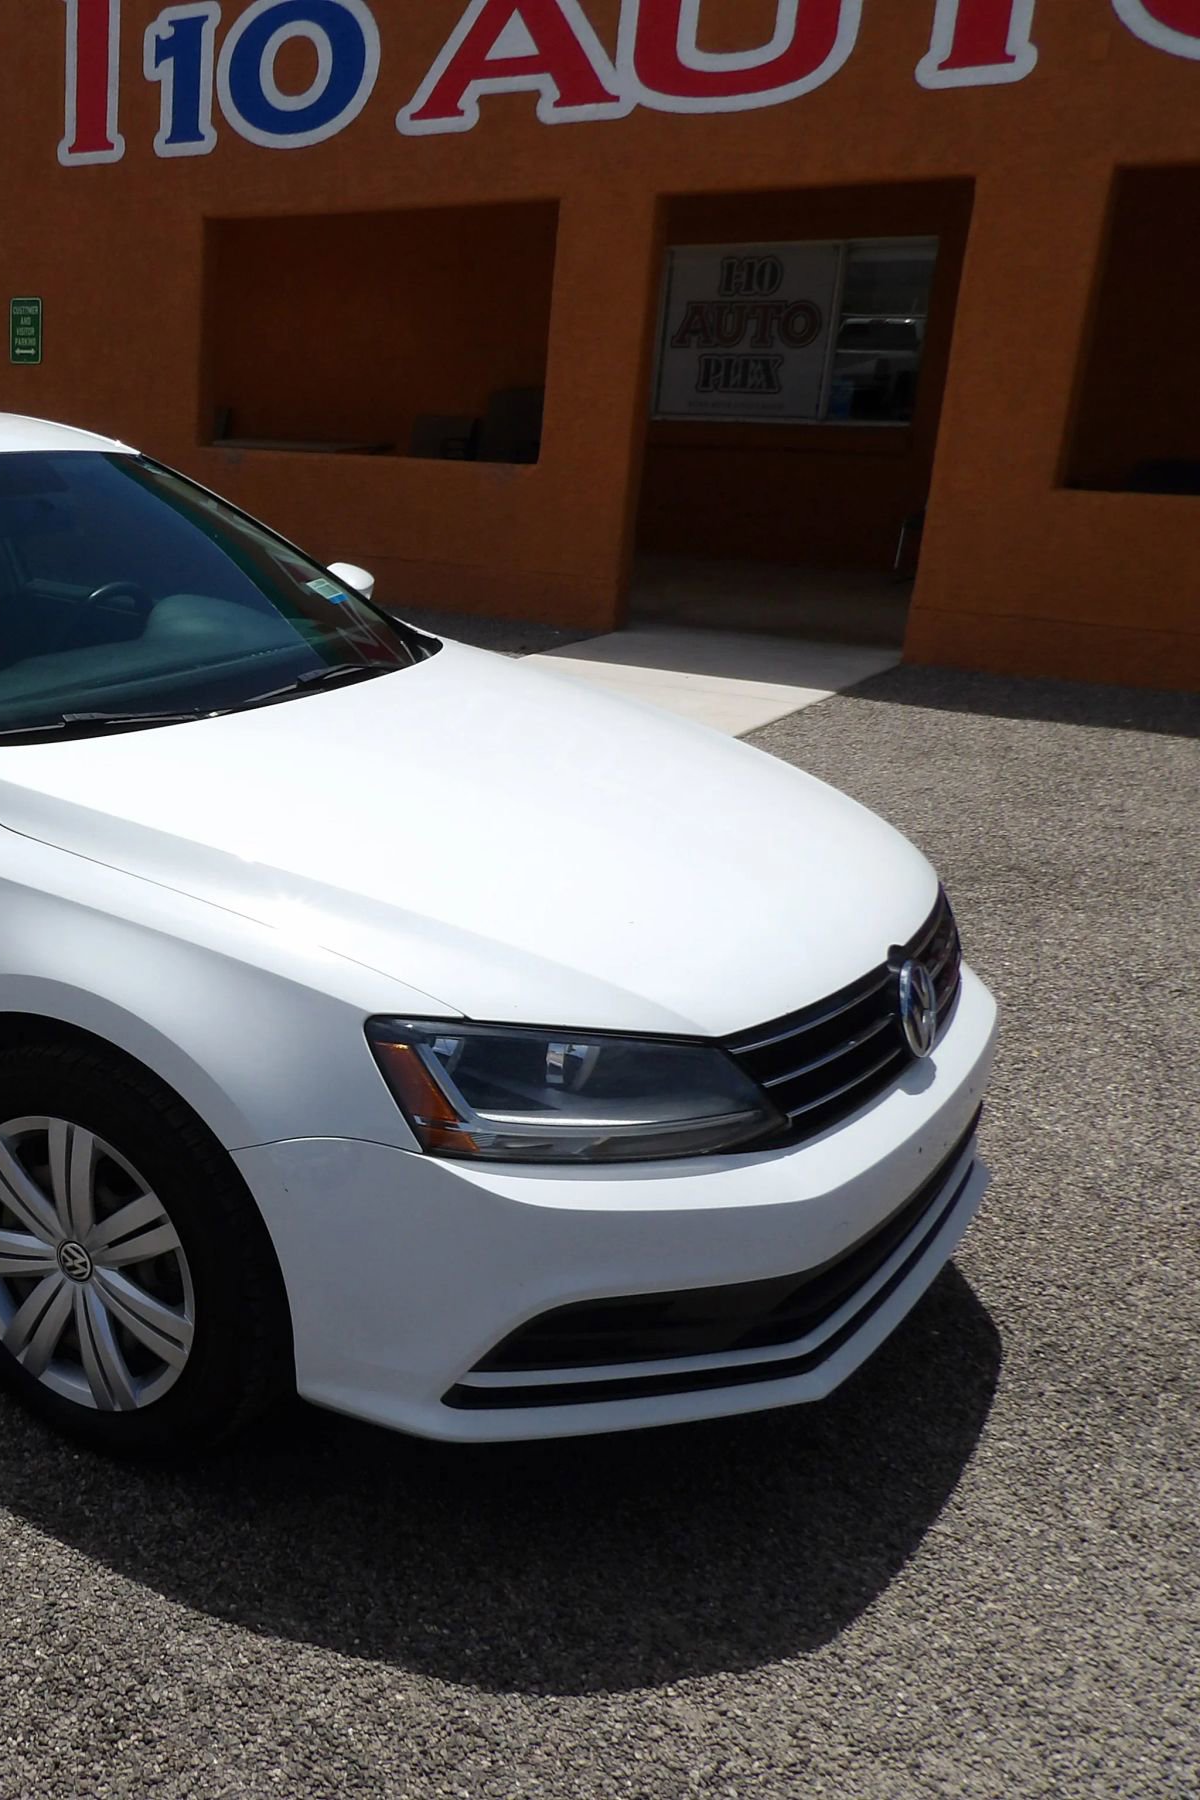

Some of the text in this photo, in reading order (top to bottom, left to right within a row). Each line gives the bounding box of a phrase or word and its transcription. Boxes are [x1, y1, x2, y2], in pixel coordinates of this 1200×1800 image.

[396, 0, 1200, 136] AUT
[14, 337, 37, 347] PARKING
[669, 300, 823, 349] AUTO
[695, 353, 785, 394] PLEX
